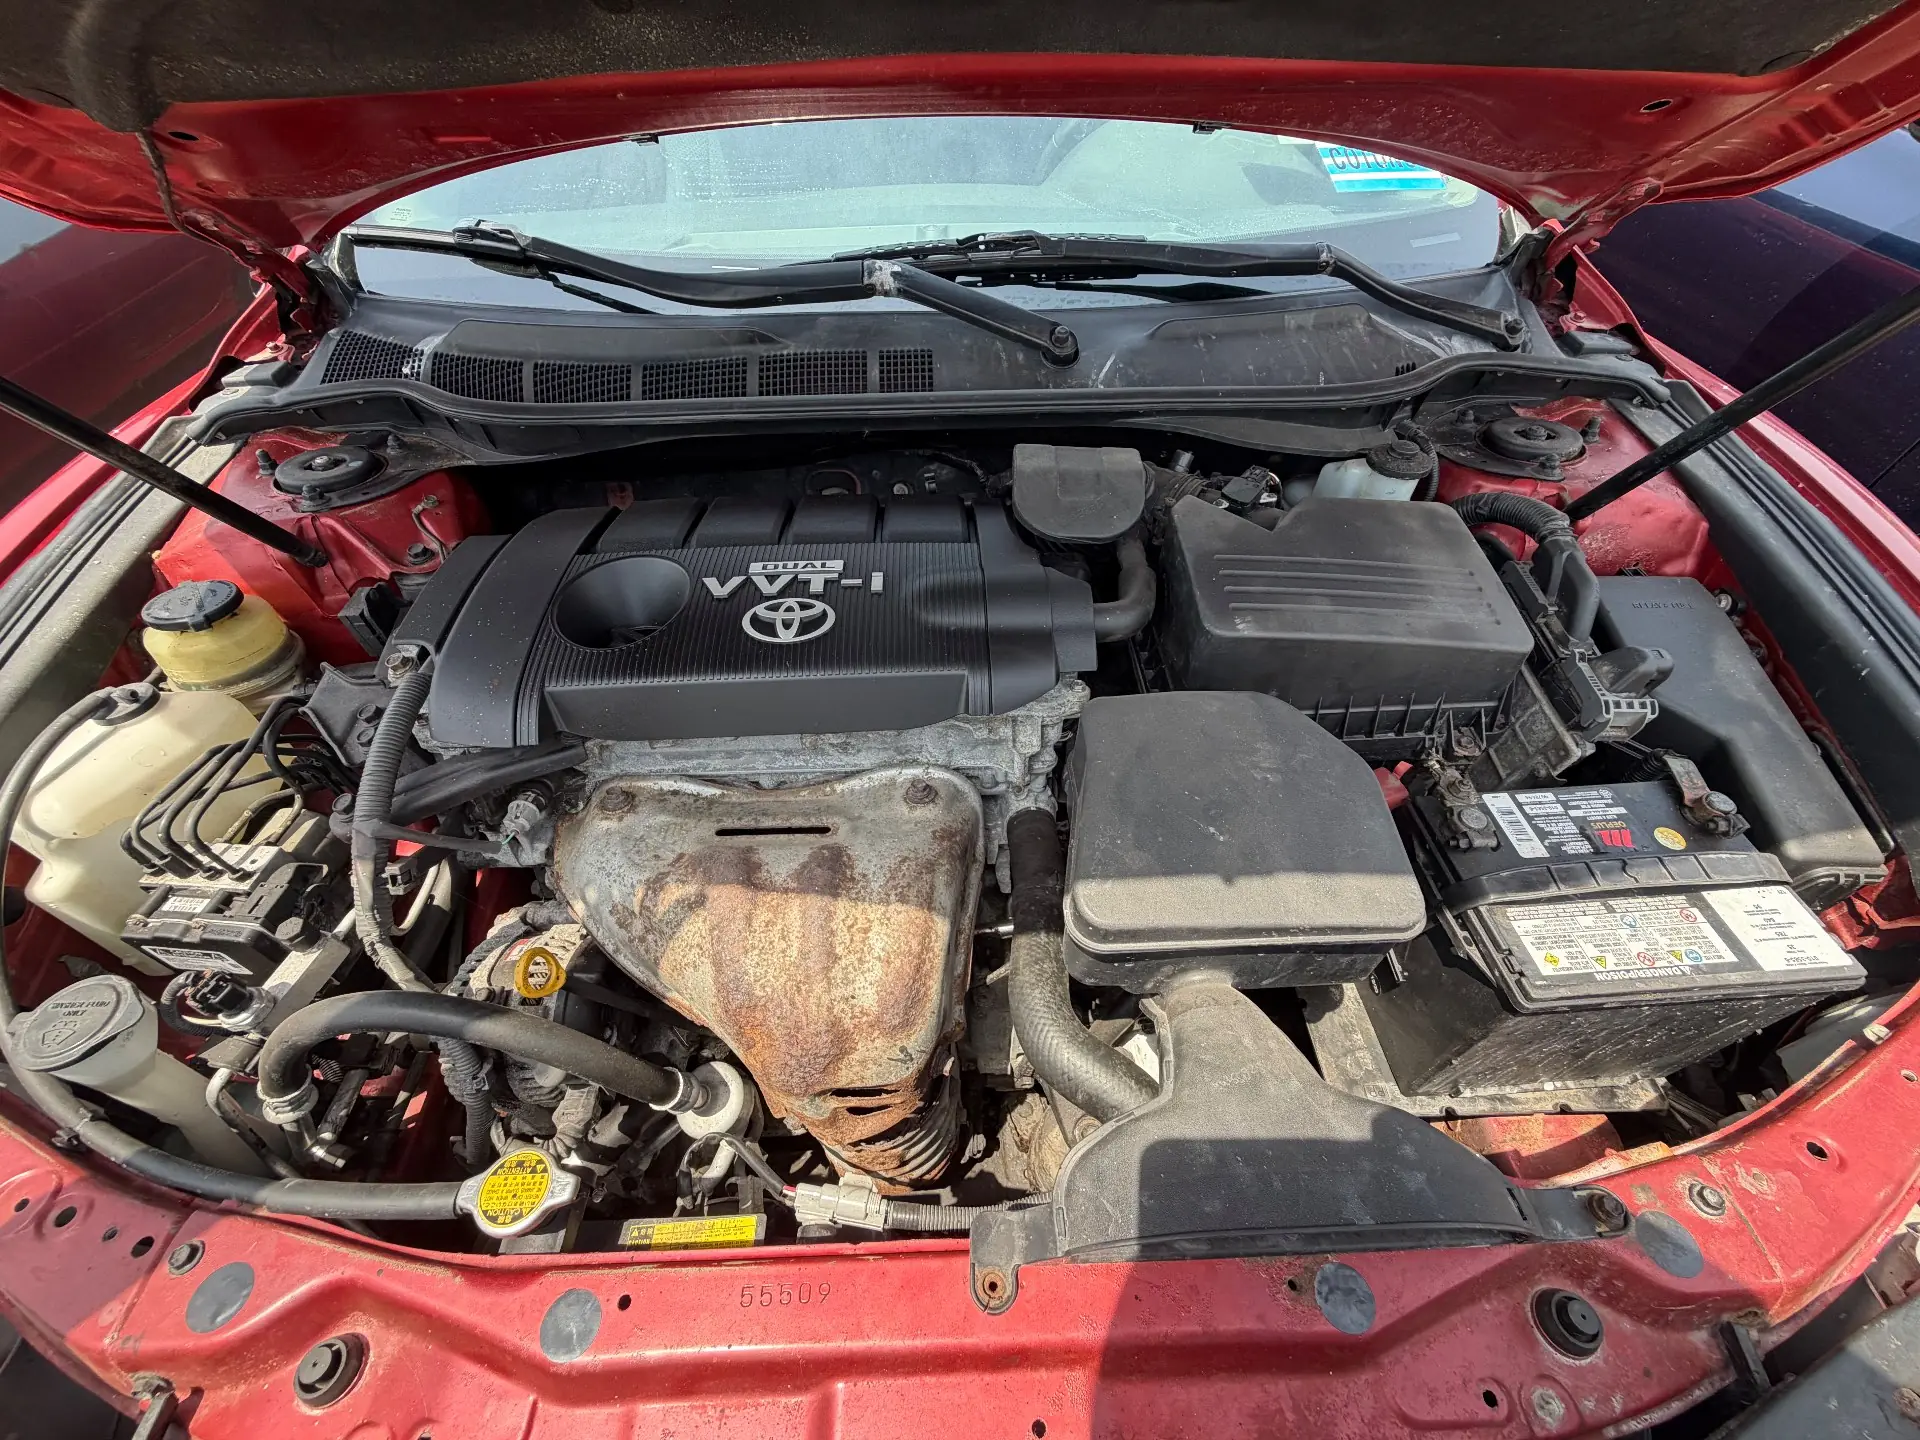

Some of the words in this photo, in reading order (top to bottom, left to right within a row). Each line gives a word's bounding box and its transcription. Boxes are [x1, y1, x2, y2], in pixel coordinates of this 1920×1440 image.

[761, 561, 836, 571] DUAL
[1594, 965, 1683, 981] DANGER/POISON
[497, 1167, 532, 1175] ATTENTION
[487, 1208, 520, 1216] CAUTION
[739, 1281, 832, 1308] 55509
